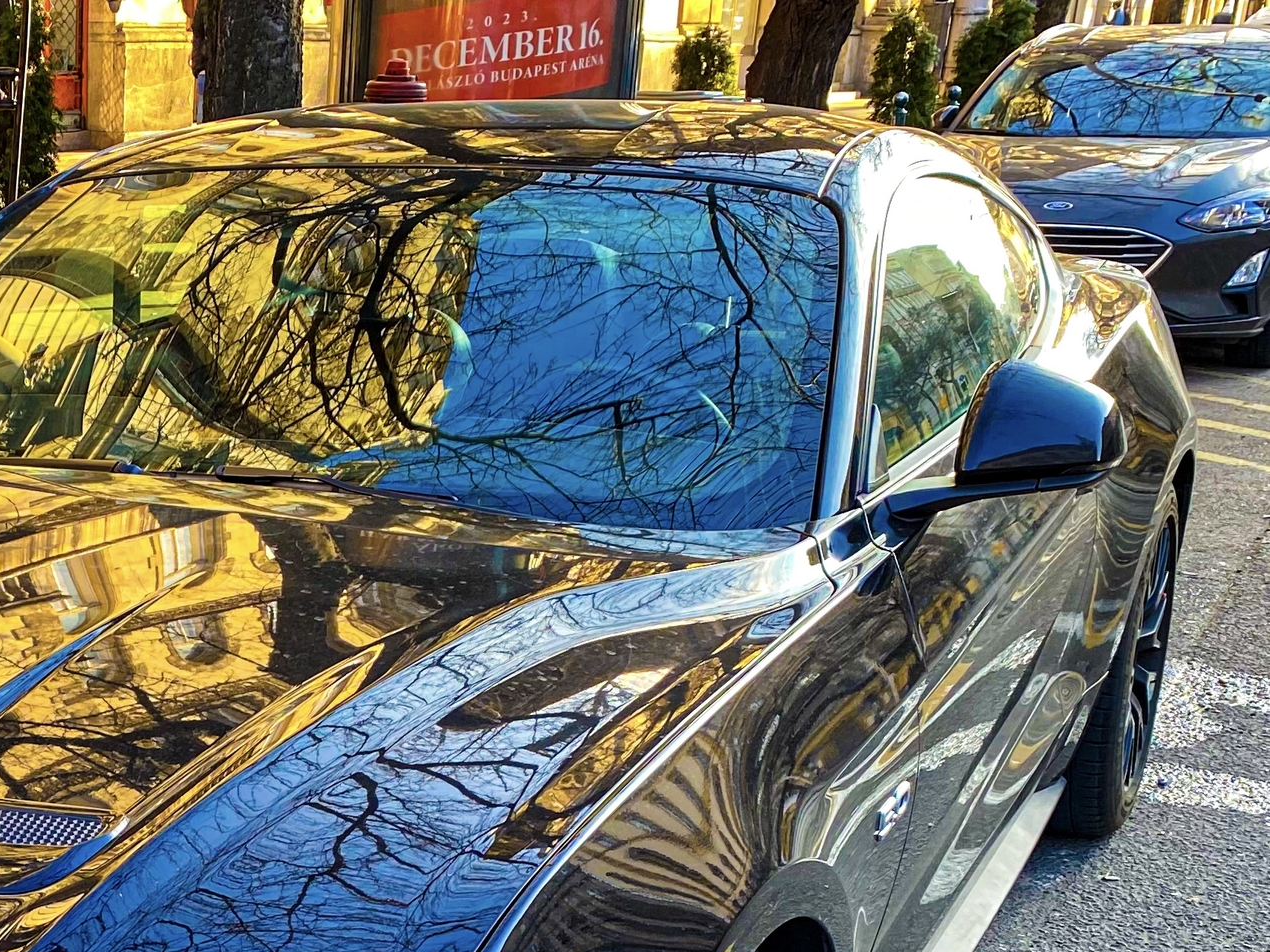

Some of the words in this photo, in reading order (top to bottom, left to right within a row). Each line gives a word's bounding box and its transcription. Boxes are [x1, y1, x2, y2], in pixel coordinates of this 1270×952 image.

[579, 18, 604, 50] 16.
[491, 61, 566, 83] BUDAPEST
[569, 53, 604, 71] ARÉNA
